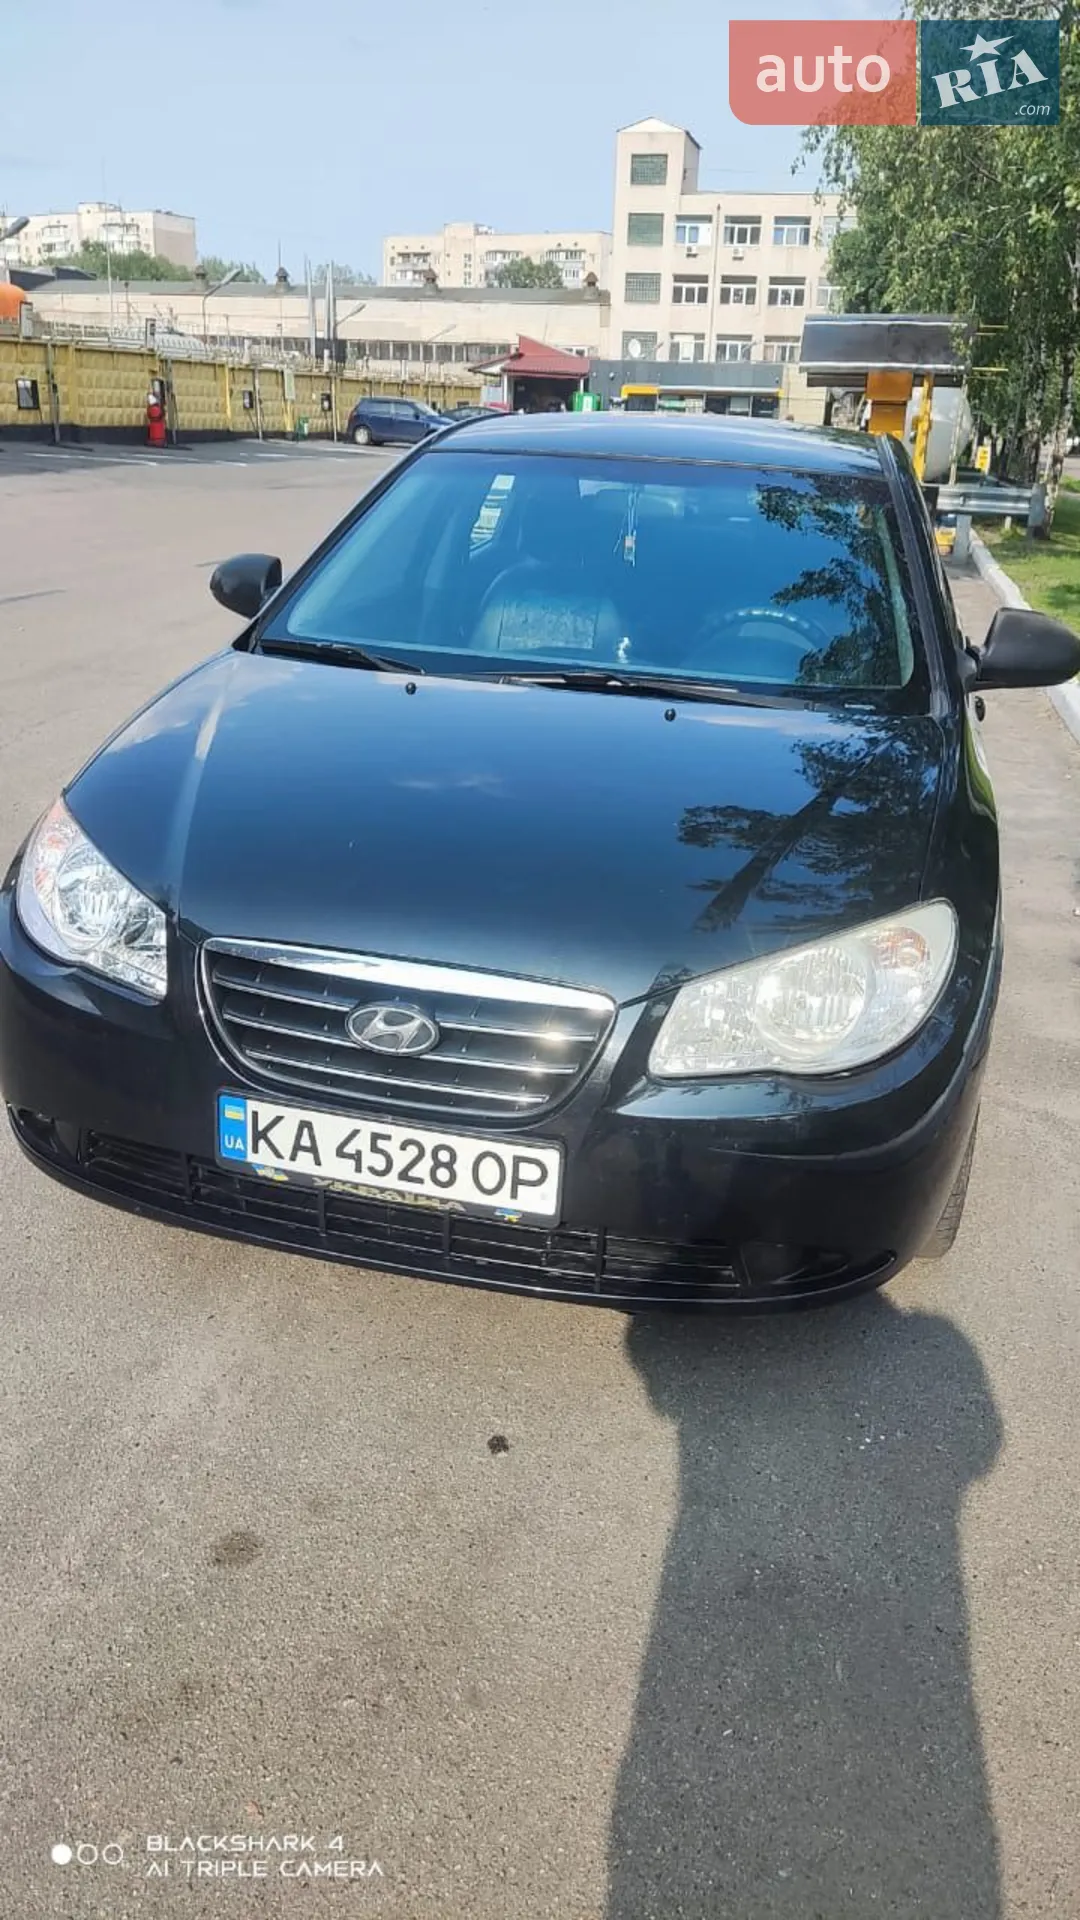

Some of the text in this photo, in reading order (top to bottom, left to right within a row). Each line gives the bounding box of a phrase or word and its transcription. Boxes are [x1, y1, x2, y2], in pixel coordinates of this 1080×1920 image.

[224, 1135, 245, 1152] UA
[251, 1109, 322, 1167] KA
[335, 1128, 457, 1189] 4528
[471, 1151, 549, 1200] OP
